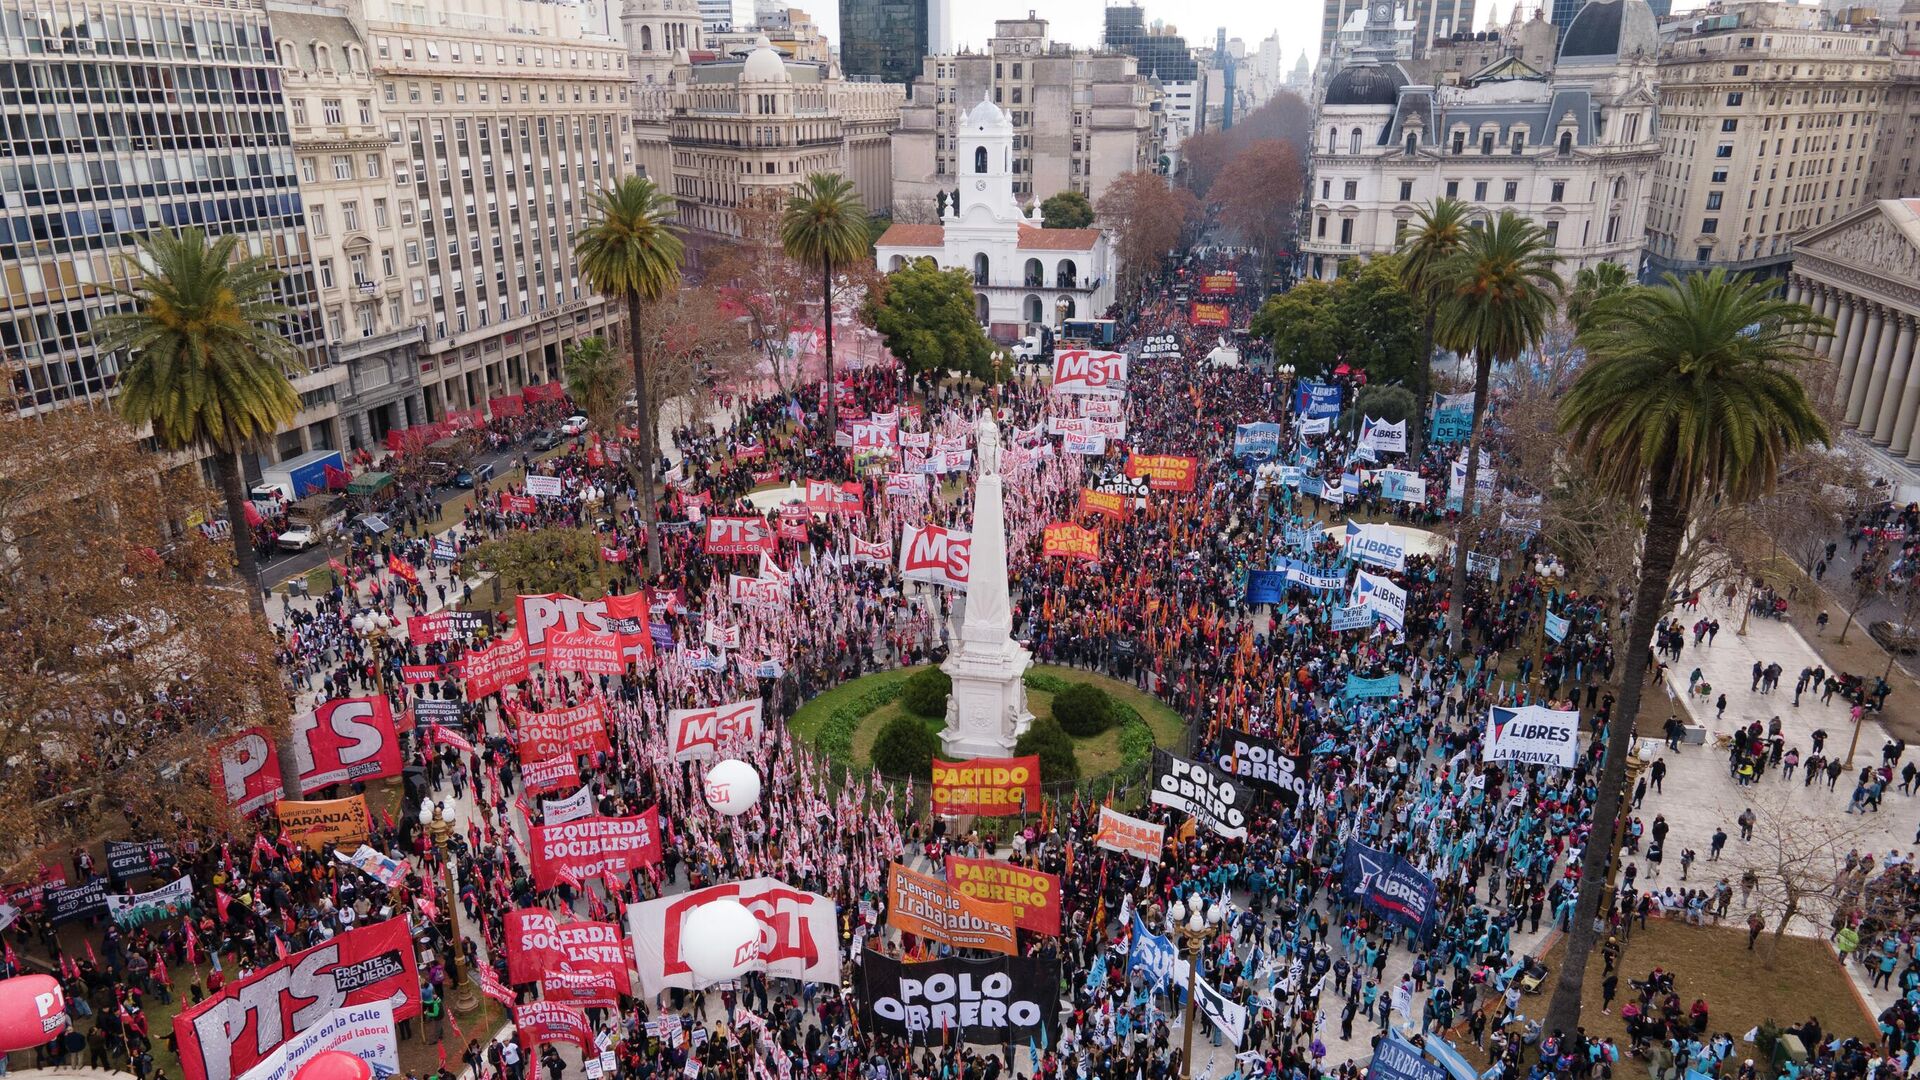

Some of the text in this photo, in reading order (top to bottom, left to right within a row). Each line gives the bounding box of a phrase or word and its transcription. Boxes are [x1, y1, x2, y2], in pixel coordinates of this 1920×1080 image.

[530, 300, 588, 323] LA FRANCO ARGENTINA
[1143, 343, 1180, 353] OBRERO
[1147, 335, 1175, 345] POLO
[1058, 352, 1121, 385] MST
[1373, 428, 1402, 439] LIBRES
[1437, 428, 1472, 439] DE PIE
[1439, 417, 1472, 428] BARRIOS
[1247, 430, 1276, 438] LIBRES
[1134, 456, 1190, 470] PARTIDO
[1135, 467, 1188, 480] OBRERO
[810, 483, 844, 503] PTS
[1398, 485, 1421, 494] LIBRES
[710, 519, 761, 542] PTS
[857, 542, 891, 559] MST
[911, 530, 970, 580] MS
[1357, 537, 1403, 559] LIBRES
[1299, 573, 1316, 586] DEL
[1320, 578, 1341, 588] SUR
[1301, 562, 1338, 578] LIBRES
[1373, 584, 1405, 611] LIBRES
[422, 619, 482, 631] ASAMBLEAS
[523, 599, 609, 645] PTS
[434, 632, 473, 641] PUEBLO
[553, 647, 618, 661] IZQUIERDA
[406, 670, 436, 679] UNION
[477, 676, 490, 689] La
[520, 703, 599, 727] IZQUIERDA
[681, 709, 753, 750] MST
[1510, 722, 1570, 743] LIBRES
[1234, 740, 1295, 773] POLO
[1493, 748, 1561, 765] LA MATANZA
[932, 766, 1029, 786] PARTIDO
[1171, 757, 1237, 805] POLO
[1219, 754, 1305, 797] OBRERO
[933, 786, 1025, 805] OBRERO
[1160, 774, 1246, 828] OBRERO
[281, 812, 352, 828] NARANJA
[543, 818, 648, 842] IZQUIERDA
[544, 833, 651, 860] SOCIALISTA
[112, 854, 145, 868] CEFYL
[571, 857, 626, 879] NORTE
[954, 863, 1050, 894] PARTIDO
[896, 874, 943, 907] Plenario
[944, 895, 960, 911] de
[959, 880, 1047, 908] OBRERO
[1375, 873, 1427, 913] LIBRES
[521, 914, 618, 945] IZQERDA
[952, 935, 986, 945] OBRERO
[521, 932, 625, 964] SOCLISTA
[335, 956, 393, 979] FRENTE DE
[337, 963, 403, 991] IZQUIERDA
[900, 971, 1013, 1004] POLO
[193, 943, 349, 1080] PTS
[873, 996, 1041, 1031] OBRERO
[320, 1024, 334, 1039] en
[335, 1015, 347, 1028] la
[349, 1009, 381, 1023] Calle
[355, 1024, 390, 1039] laboral
[1378, 1041, 1426, 1080] BARRIOS
